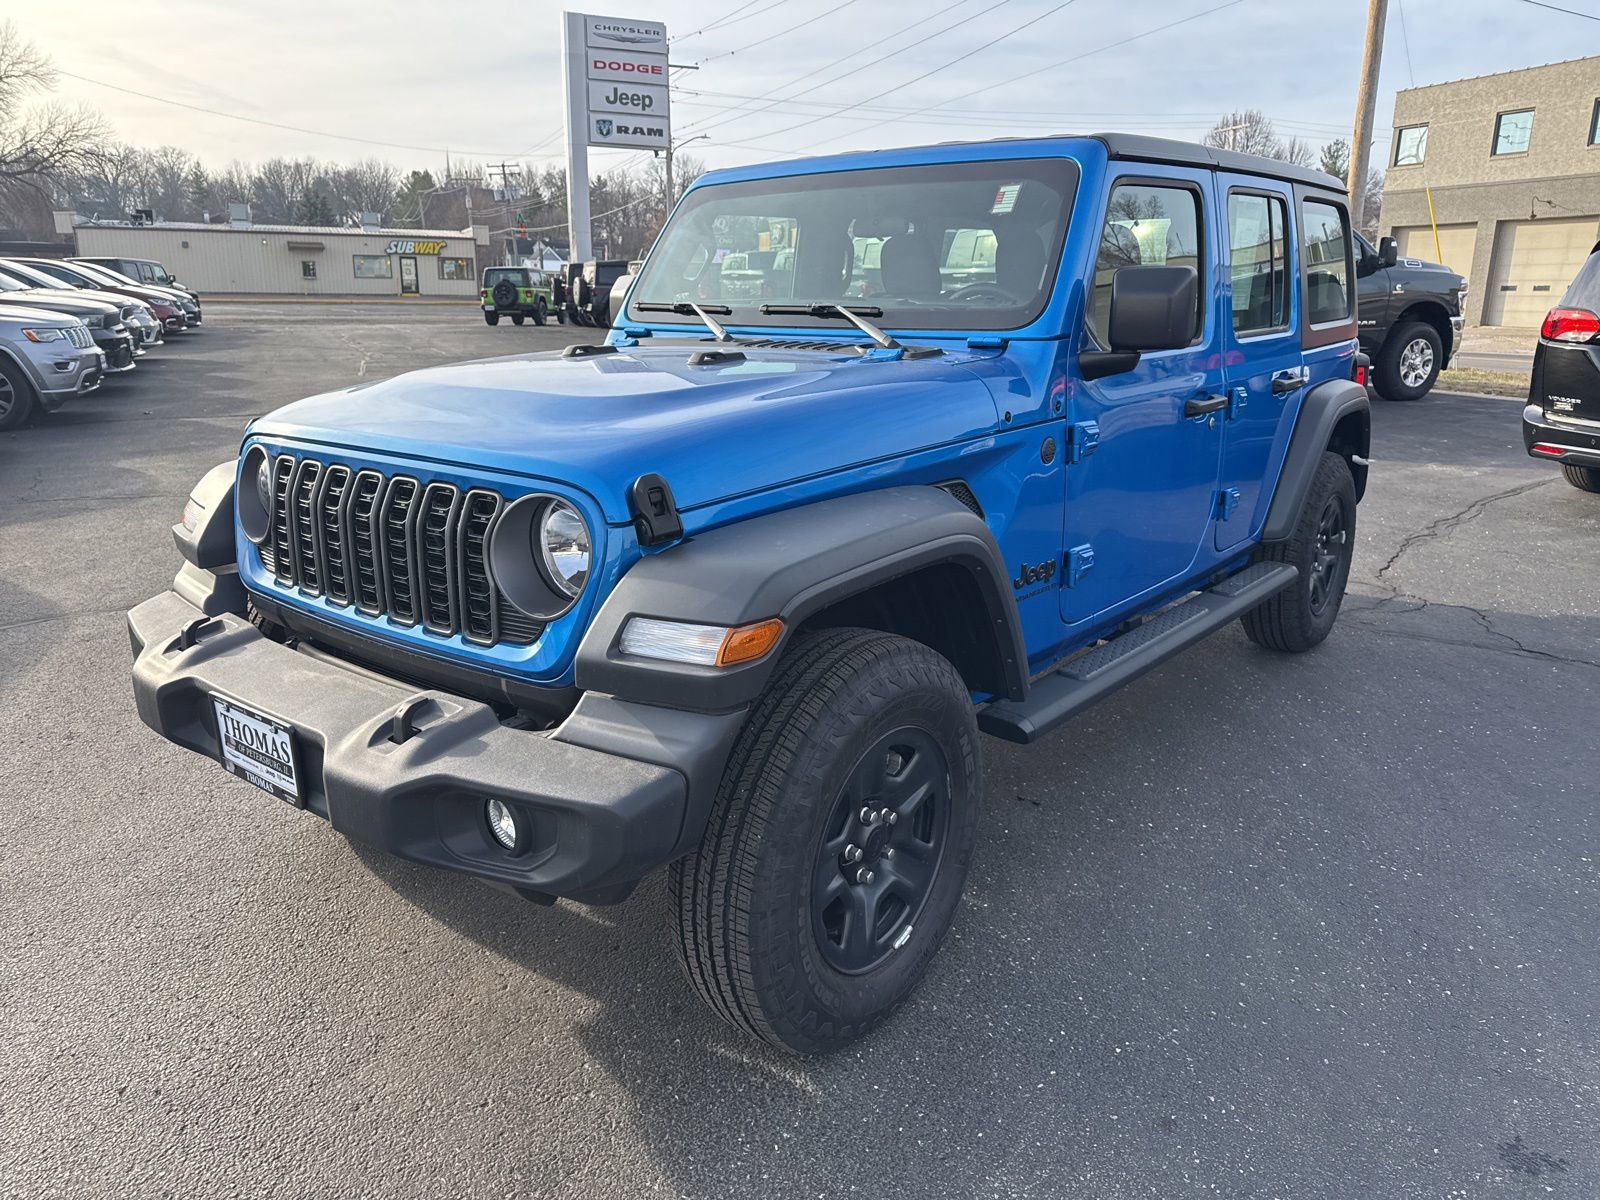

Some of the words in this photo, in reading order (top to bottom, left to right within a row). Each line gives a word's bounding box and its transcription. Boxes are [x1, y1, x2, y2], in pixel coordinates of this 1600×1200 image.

[594, 24, 661, 36] CHRYSLER
[593, 60, 663, 75] DODGE
[605, 87, 654, 111] Jeep
[616, 125, 664, 137] RAM
[386, 240, 447, 255] SUBWAY
[1014, 559, 1056, 590] Jeep
[220, 712, 291, 764] THOMAS
[245, 770, 274, 793] THOMAS
